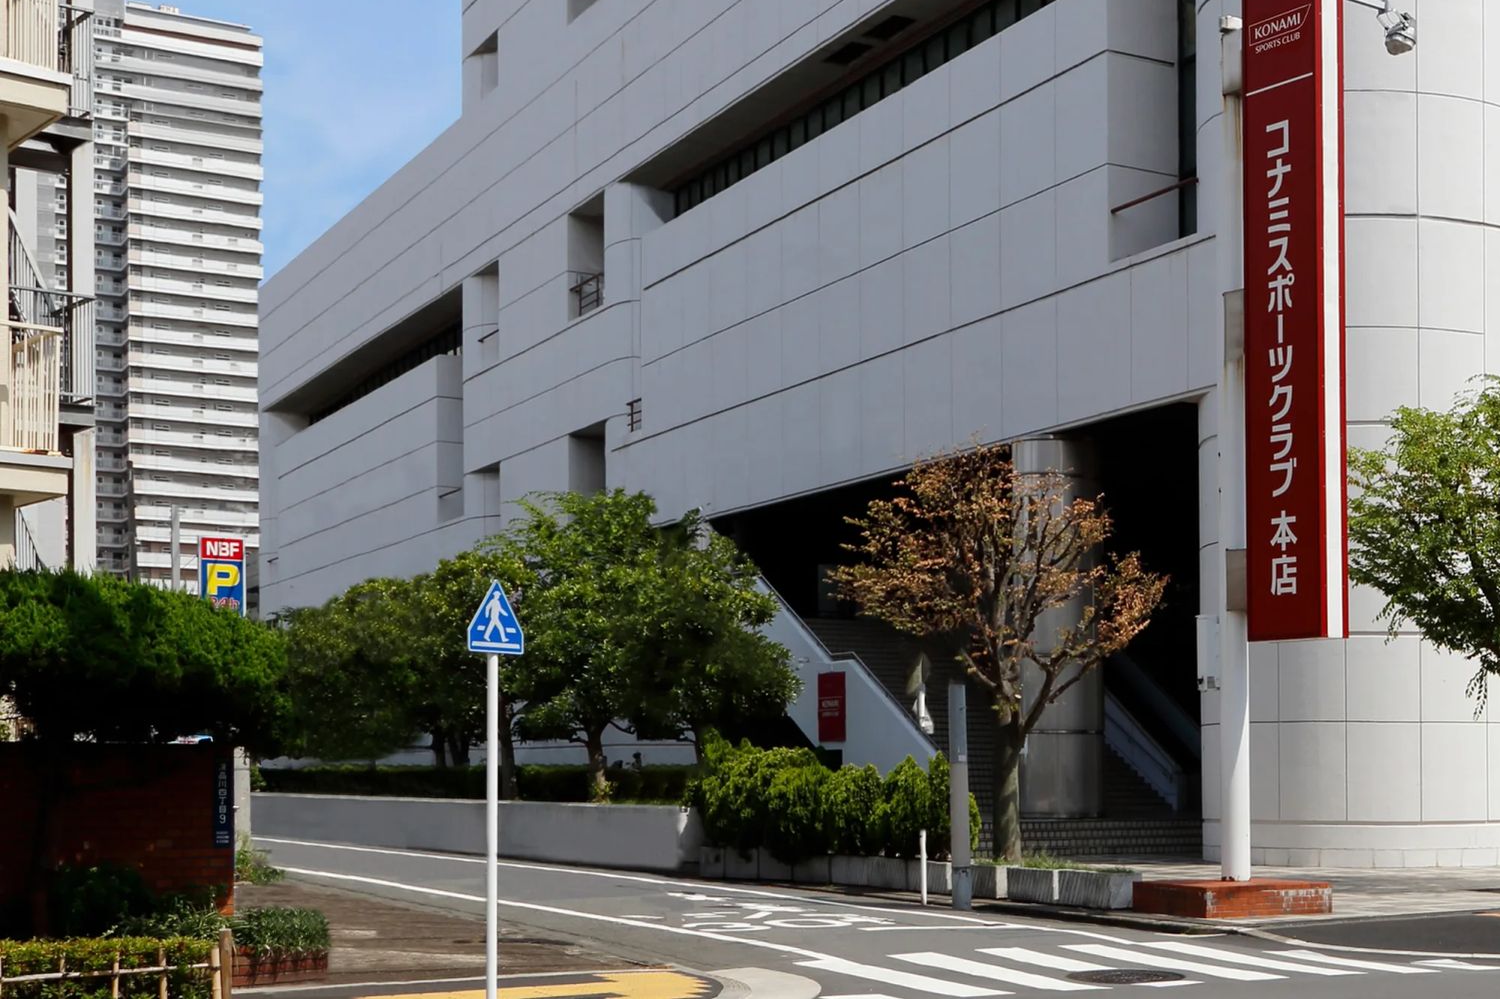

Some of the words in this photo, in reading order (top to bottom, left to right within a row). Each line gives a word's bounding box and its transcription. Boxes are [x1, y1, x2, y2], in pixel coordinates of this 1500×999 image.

[1254, 12, 1301, 39] KONAMI
[1255, 38, 1281, 54] SPORTS
[1281, 31, 1301, 45] CLUB
[1265, 118, 1297, 499] コナミスポーツクラブ
[206, 540, 240, 557] NBF
[1270, 509, 1298, 597] 本店
[206, 563, 240, 595] P
